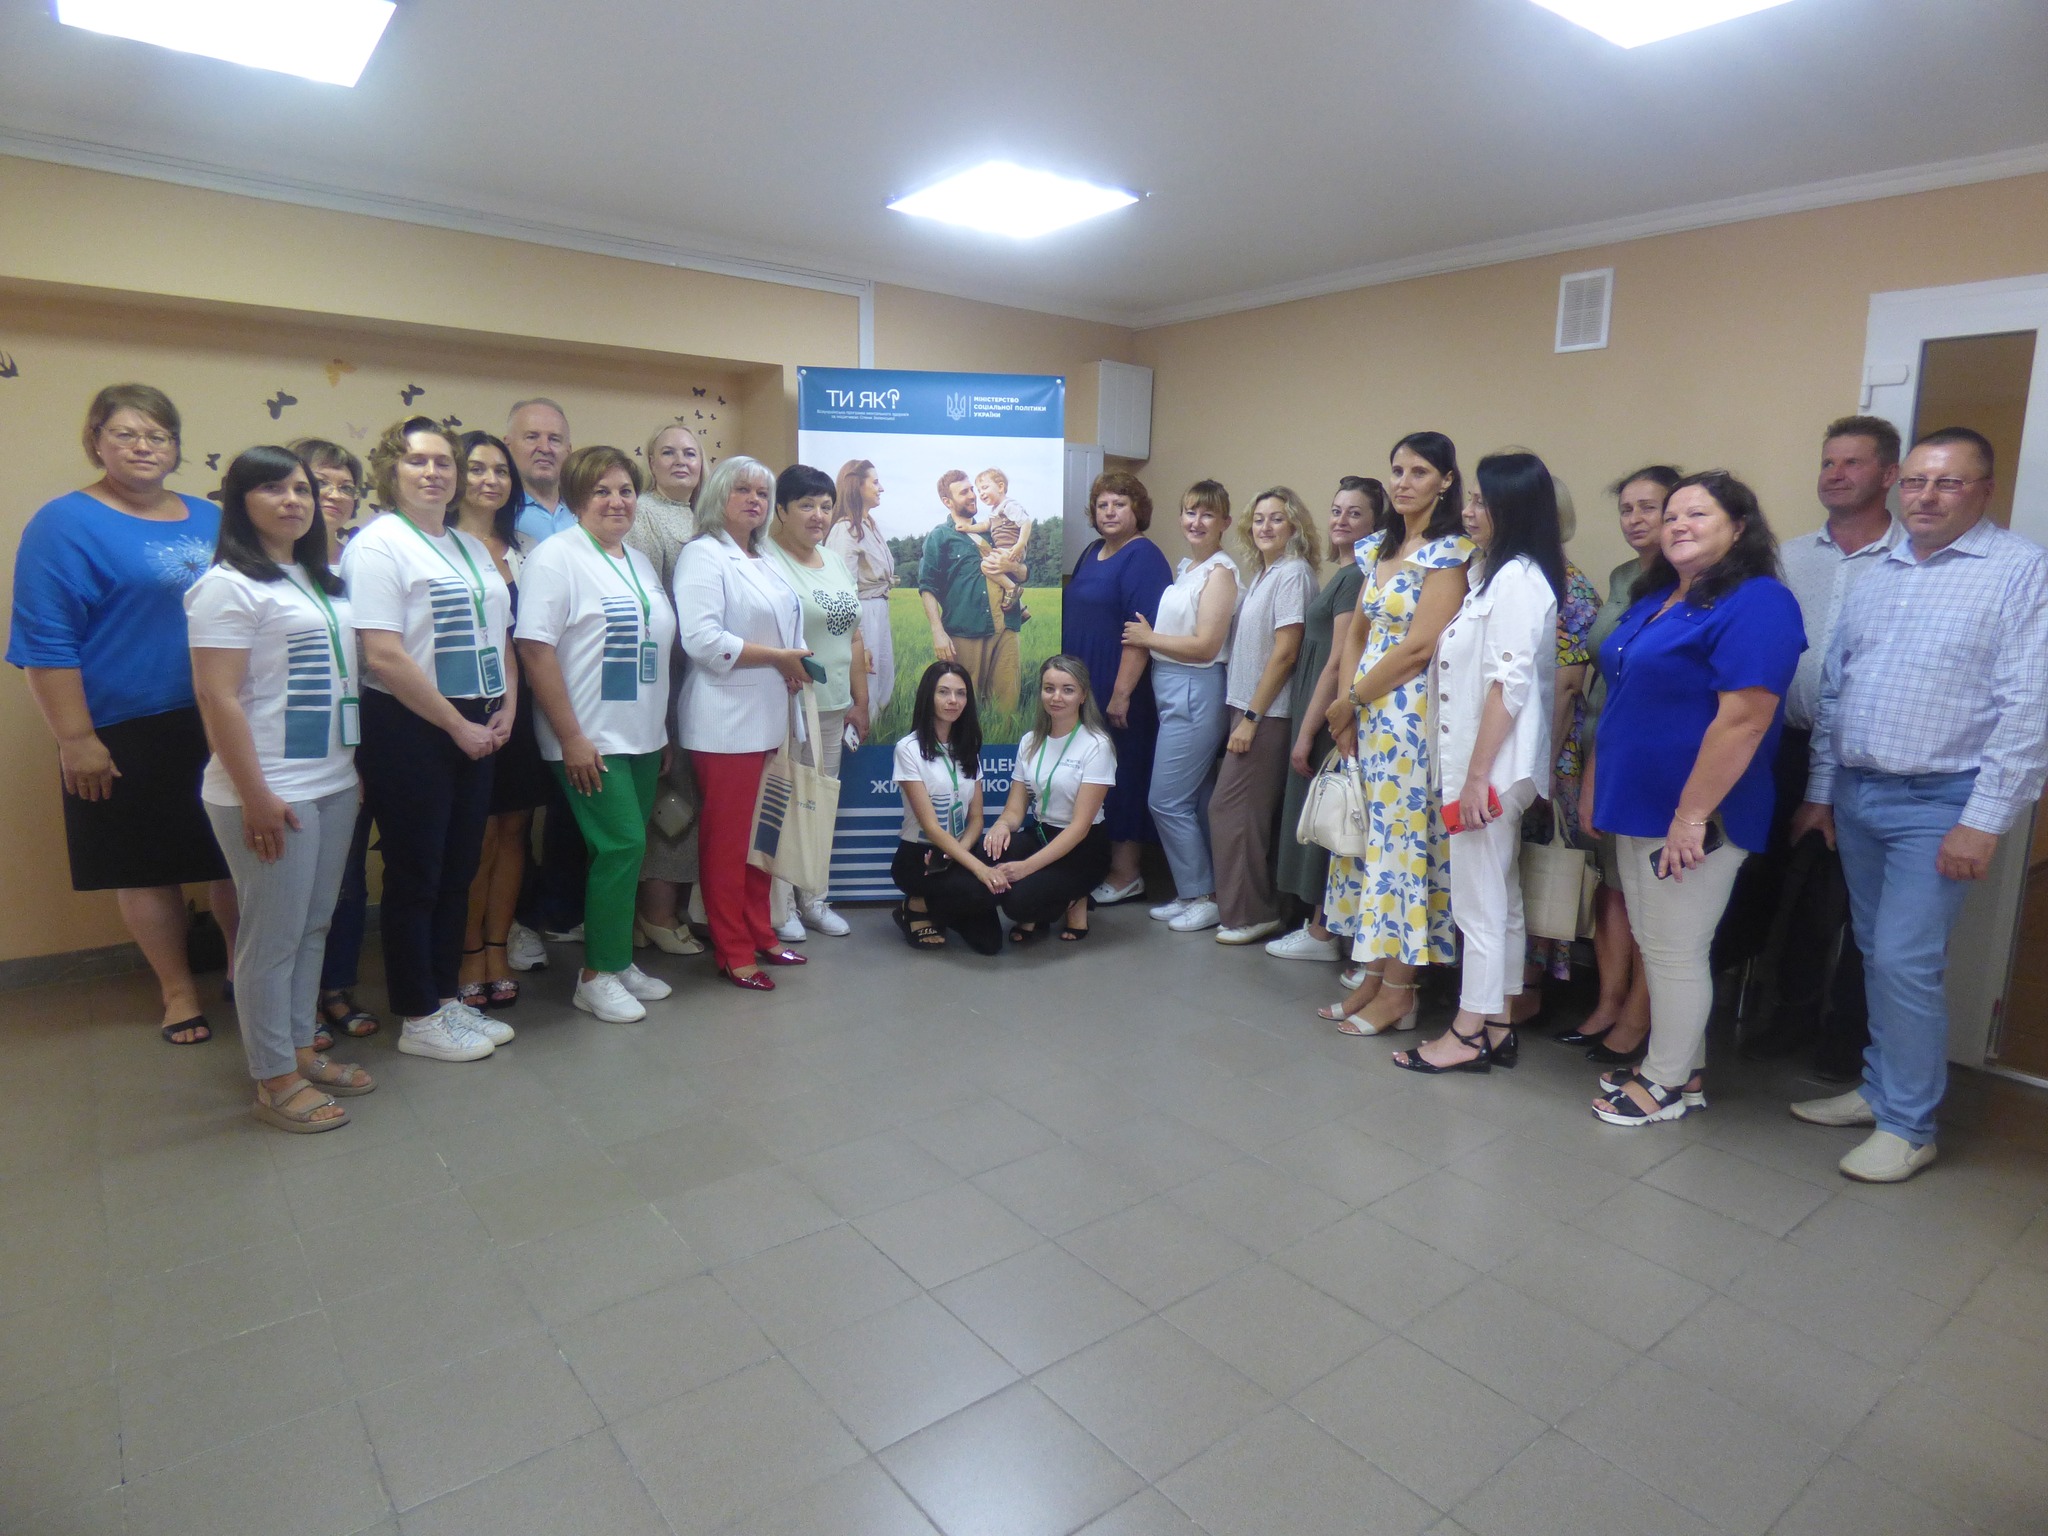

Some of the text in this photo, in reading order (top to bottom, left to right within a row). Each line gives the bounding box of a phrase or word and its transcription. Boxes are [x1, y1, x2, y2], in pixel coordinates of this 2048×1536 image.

[826, 389, 853, 408] ТИ
[973, 396, 1019, 404] МІНІСТЕРСТВО
[973, 403, 1013, 411] СОЦІАЛЬНОЇ
